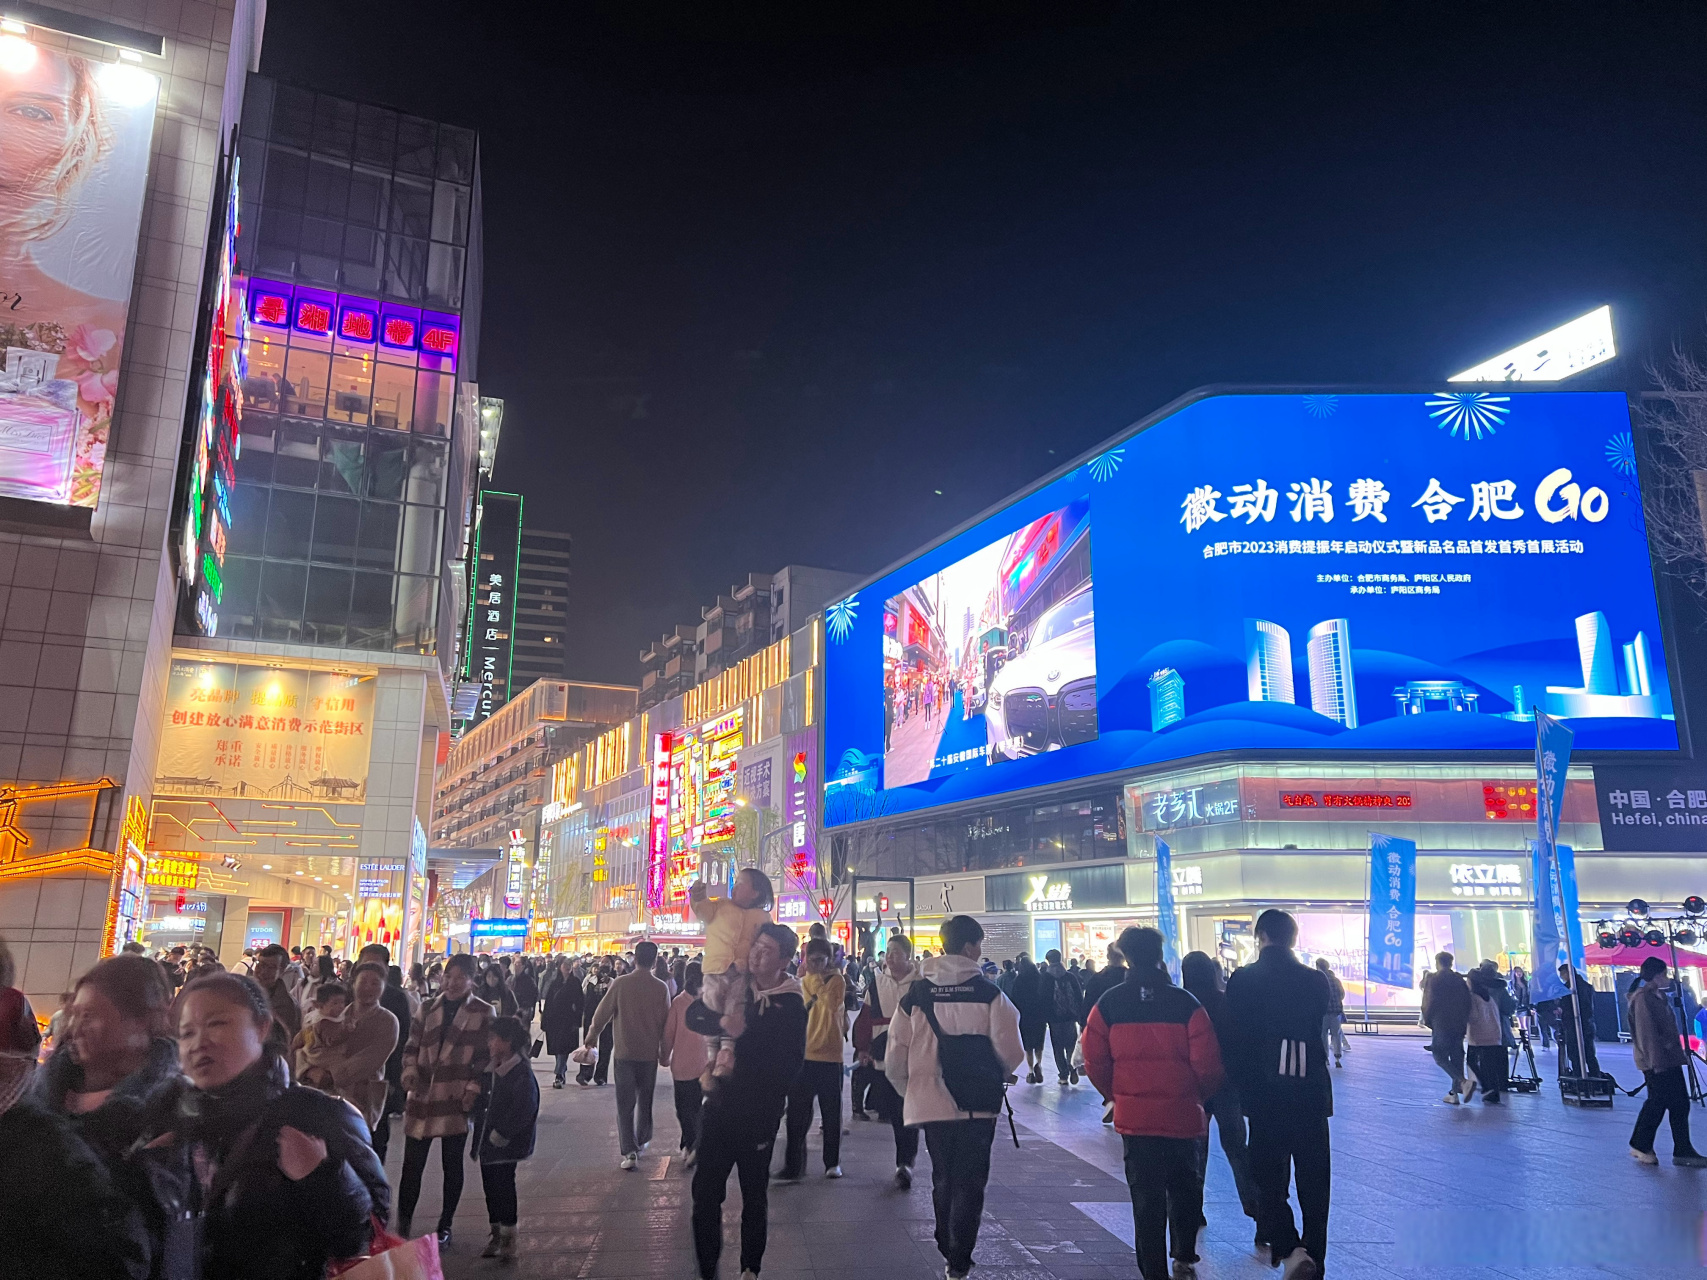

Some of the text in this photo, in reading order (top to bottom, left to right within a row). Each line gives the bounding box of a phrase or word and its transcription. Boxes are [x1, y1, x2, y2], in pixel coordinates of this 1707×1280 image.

[423, 328, 455, 349] 4F
[1179, 467, 1609, 534] 徽动消费 合肥 Go
[485, 573, 502, 641] 美居酒店
[172, 709, 364, 736] 创建放心满意消费示范街区
[1611, 812, 1662, 827] Hefei,
[1387, 852, 1402, 902] 徽动消费
[1386, 905, 1402, 933] 合肥
